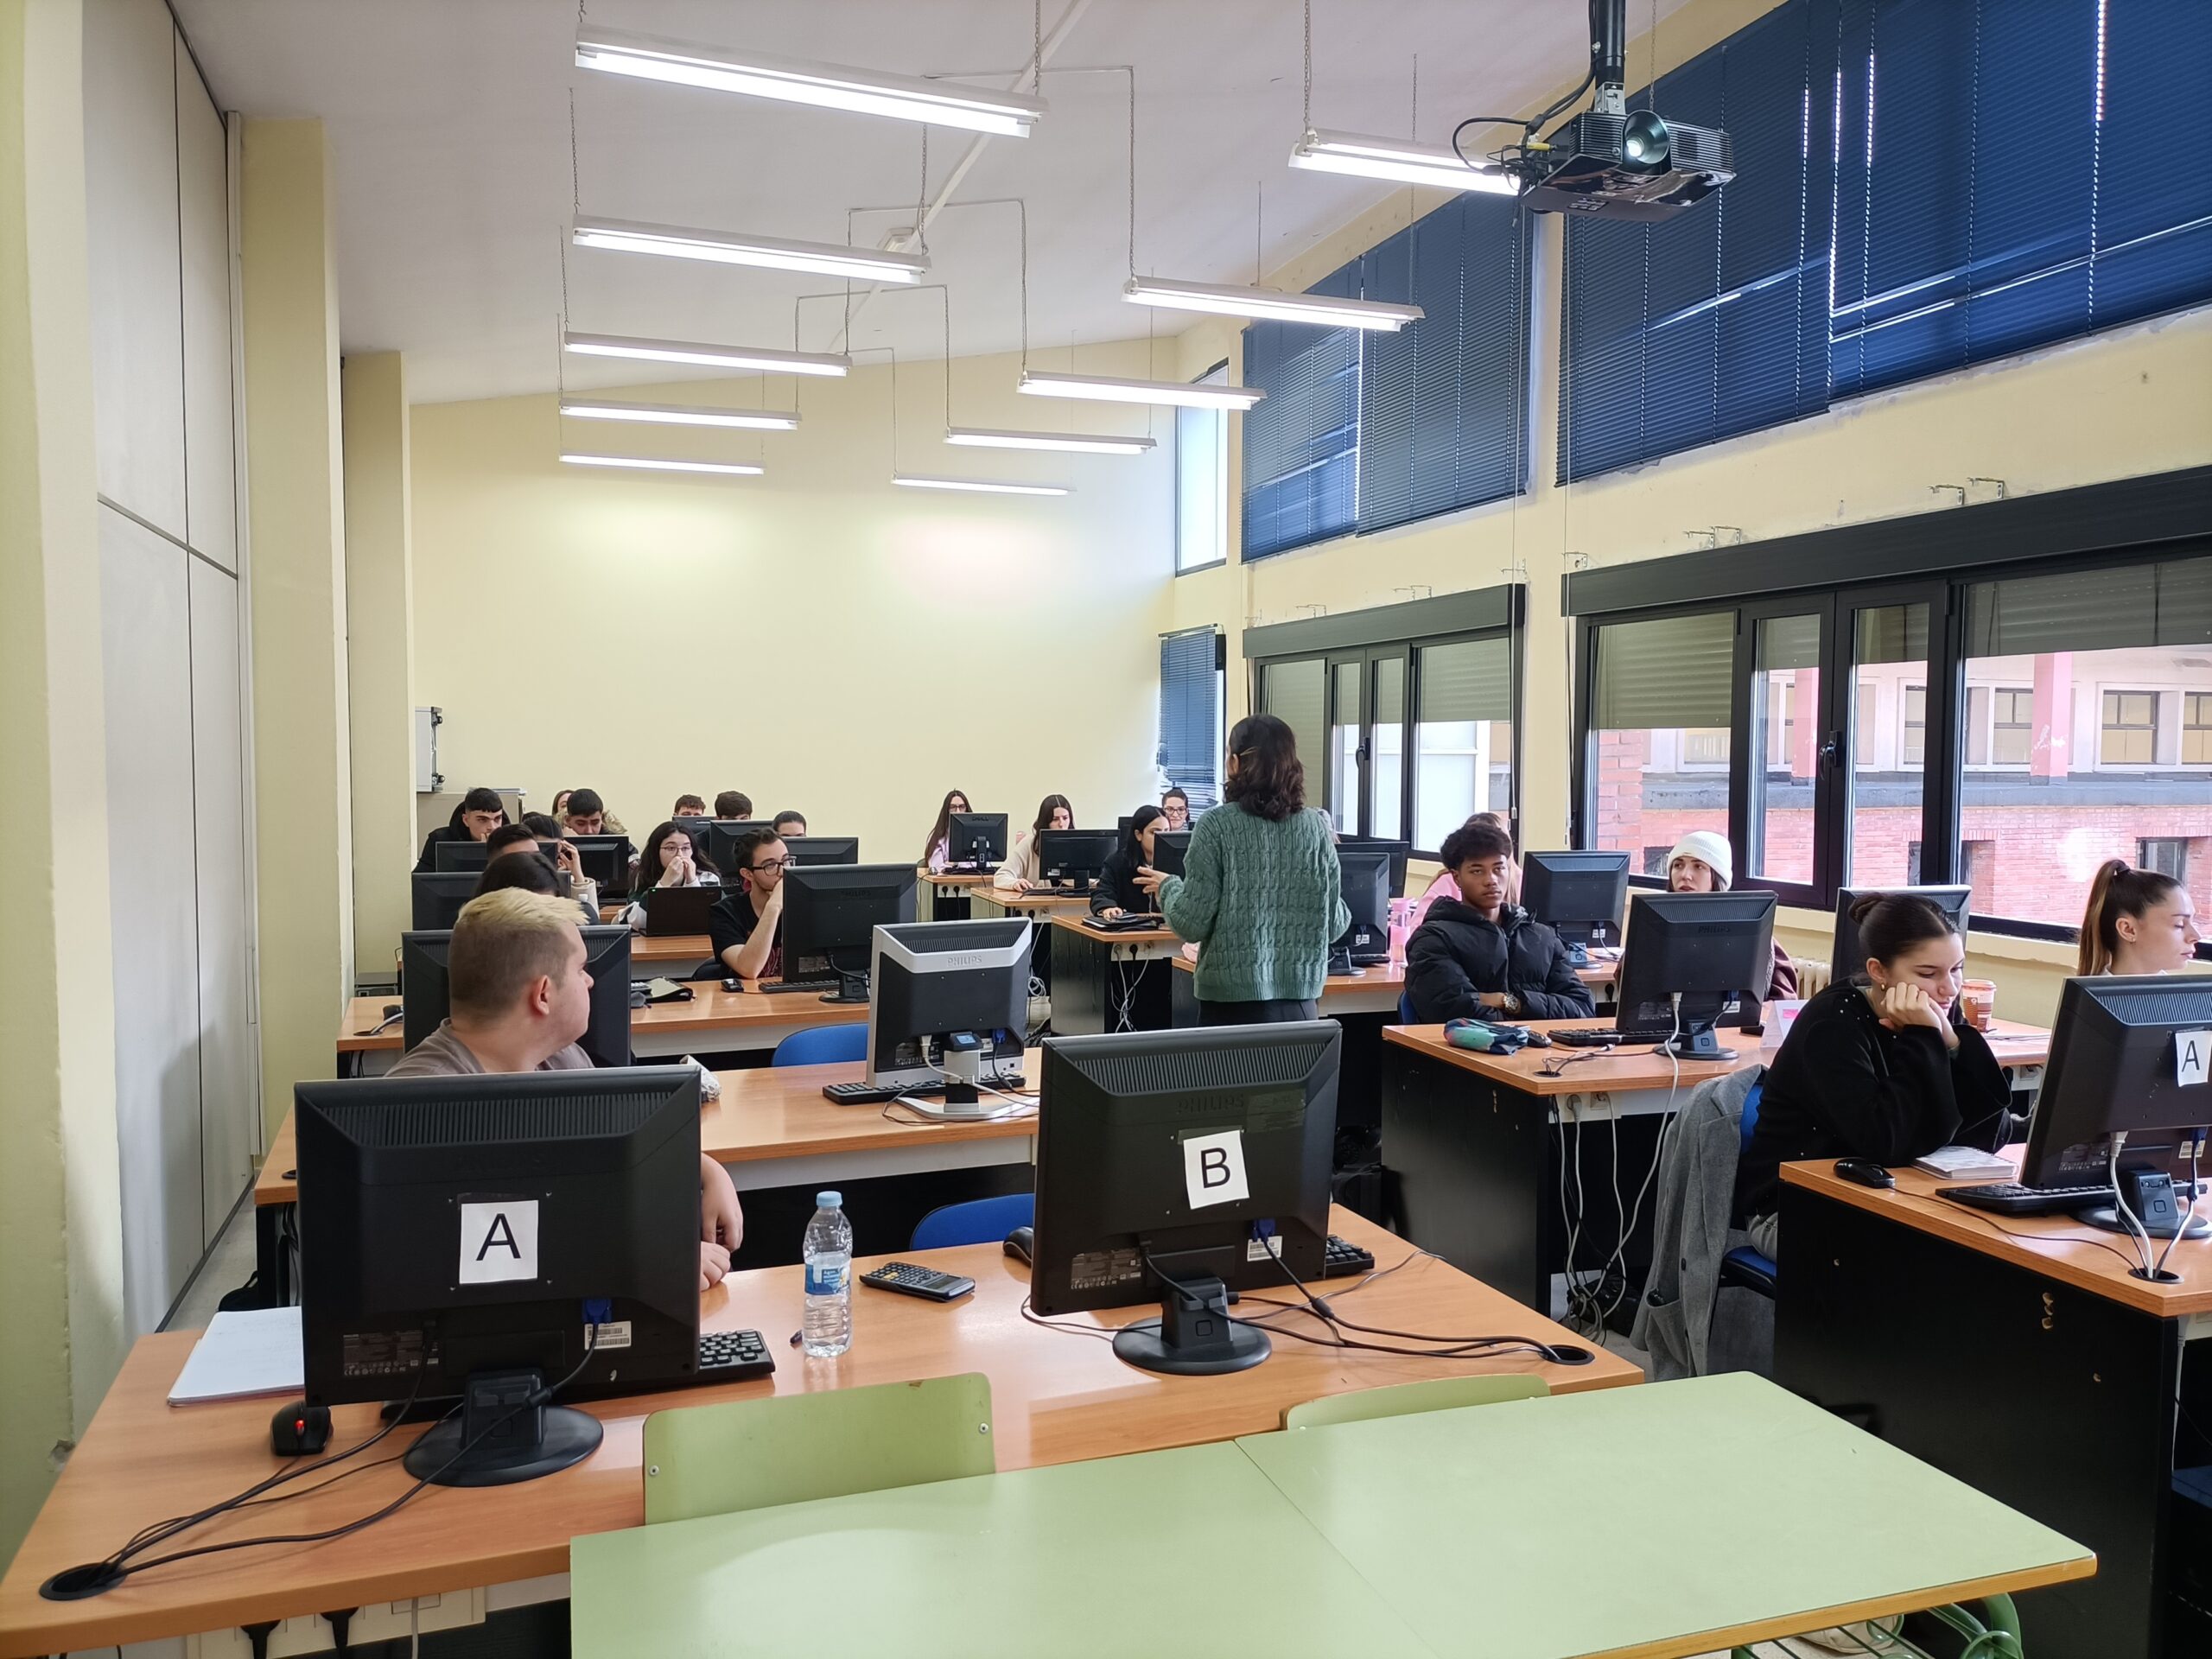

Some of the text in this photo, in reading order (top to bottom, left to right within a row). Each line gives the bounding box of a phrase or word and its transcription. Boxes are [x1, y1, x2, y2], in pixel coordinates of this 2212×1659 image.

[947, 955, 982, 967] PHILIPS
[2182, 1039, 2200, 1072] A
[1176, 1092, 1244, 1115] PHILIPS
[1200, 1147, 1231, 1189] B
[476, 1212, 521, 1262] A
